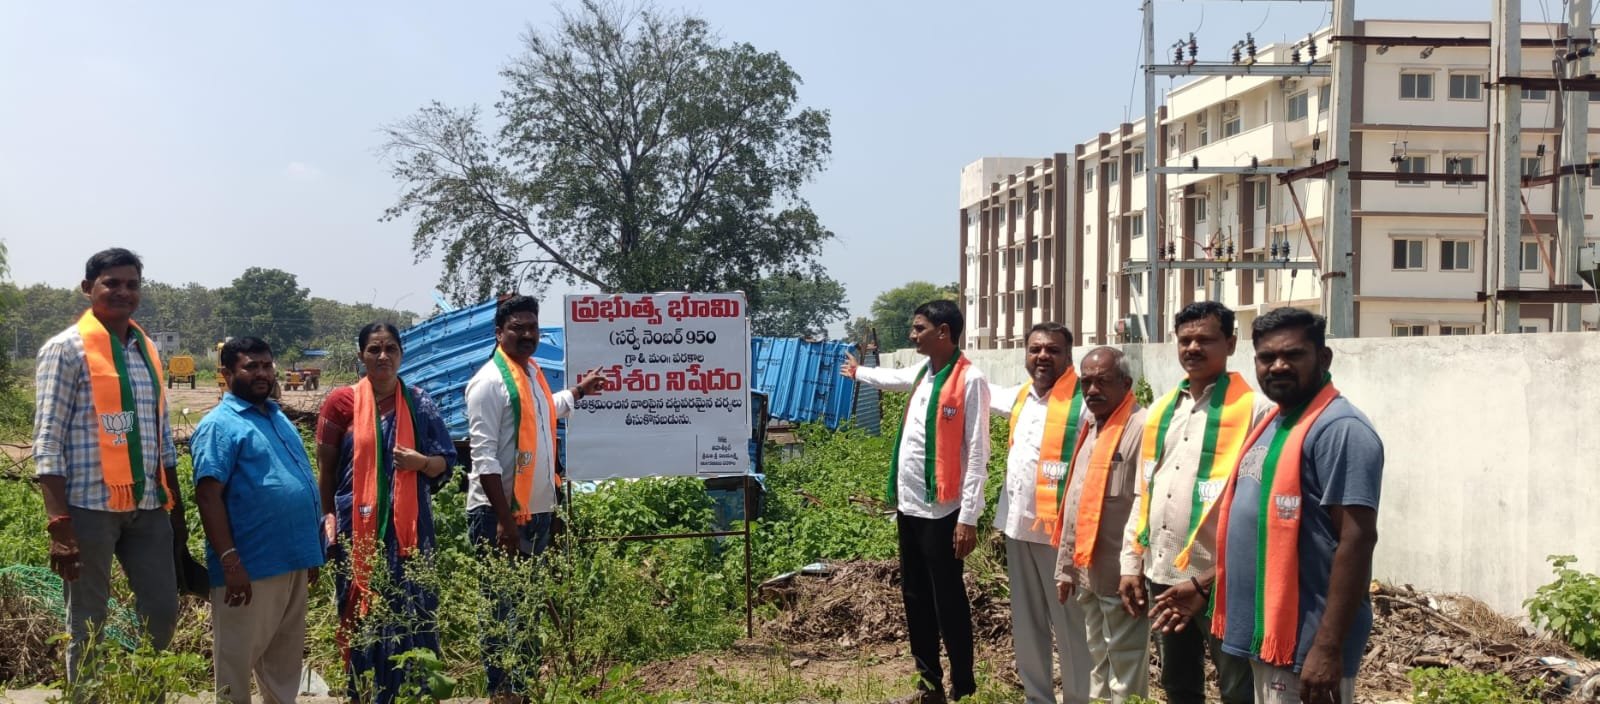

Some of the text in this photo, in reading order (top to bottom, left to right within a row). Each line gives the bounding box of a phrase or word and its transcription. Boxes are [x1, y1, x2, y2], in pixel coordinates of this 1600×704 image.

[571, 295, 739, 325] ప్రభుత్వ భూమి
[642, 328, 683, 345] నెంబర్
[686, 330, 717, 345] 950
[672, 352, 704, 363] పరకాల
[630, 398, 664, 413] వారిపైన
[666, 397, 713, 412] చట్టపరమైన
